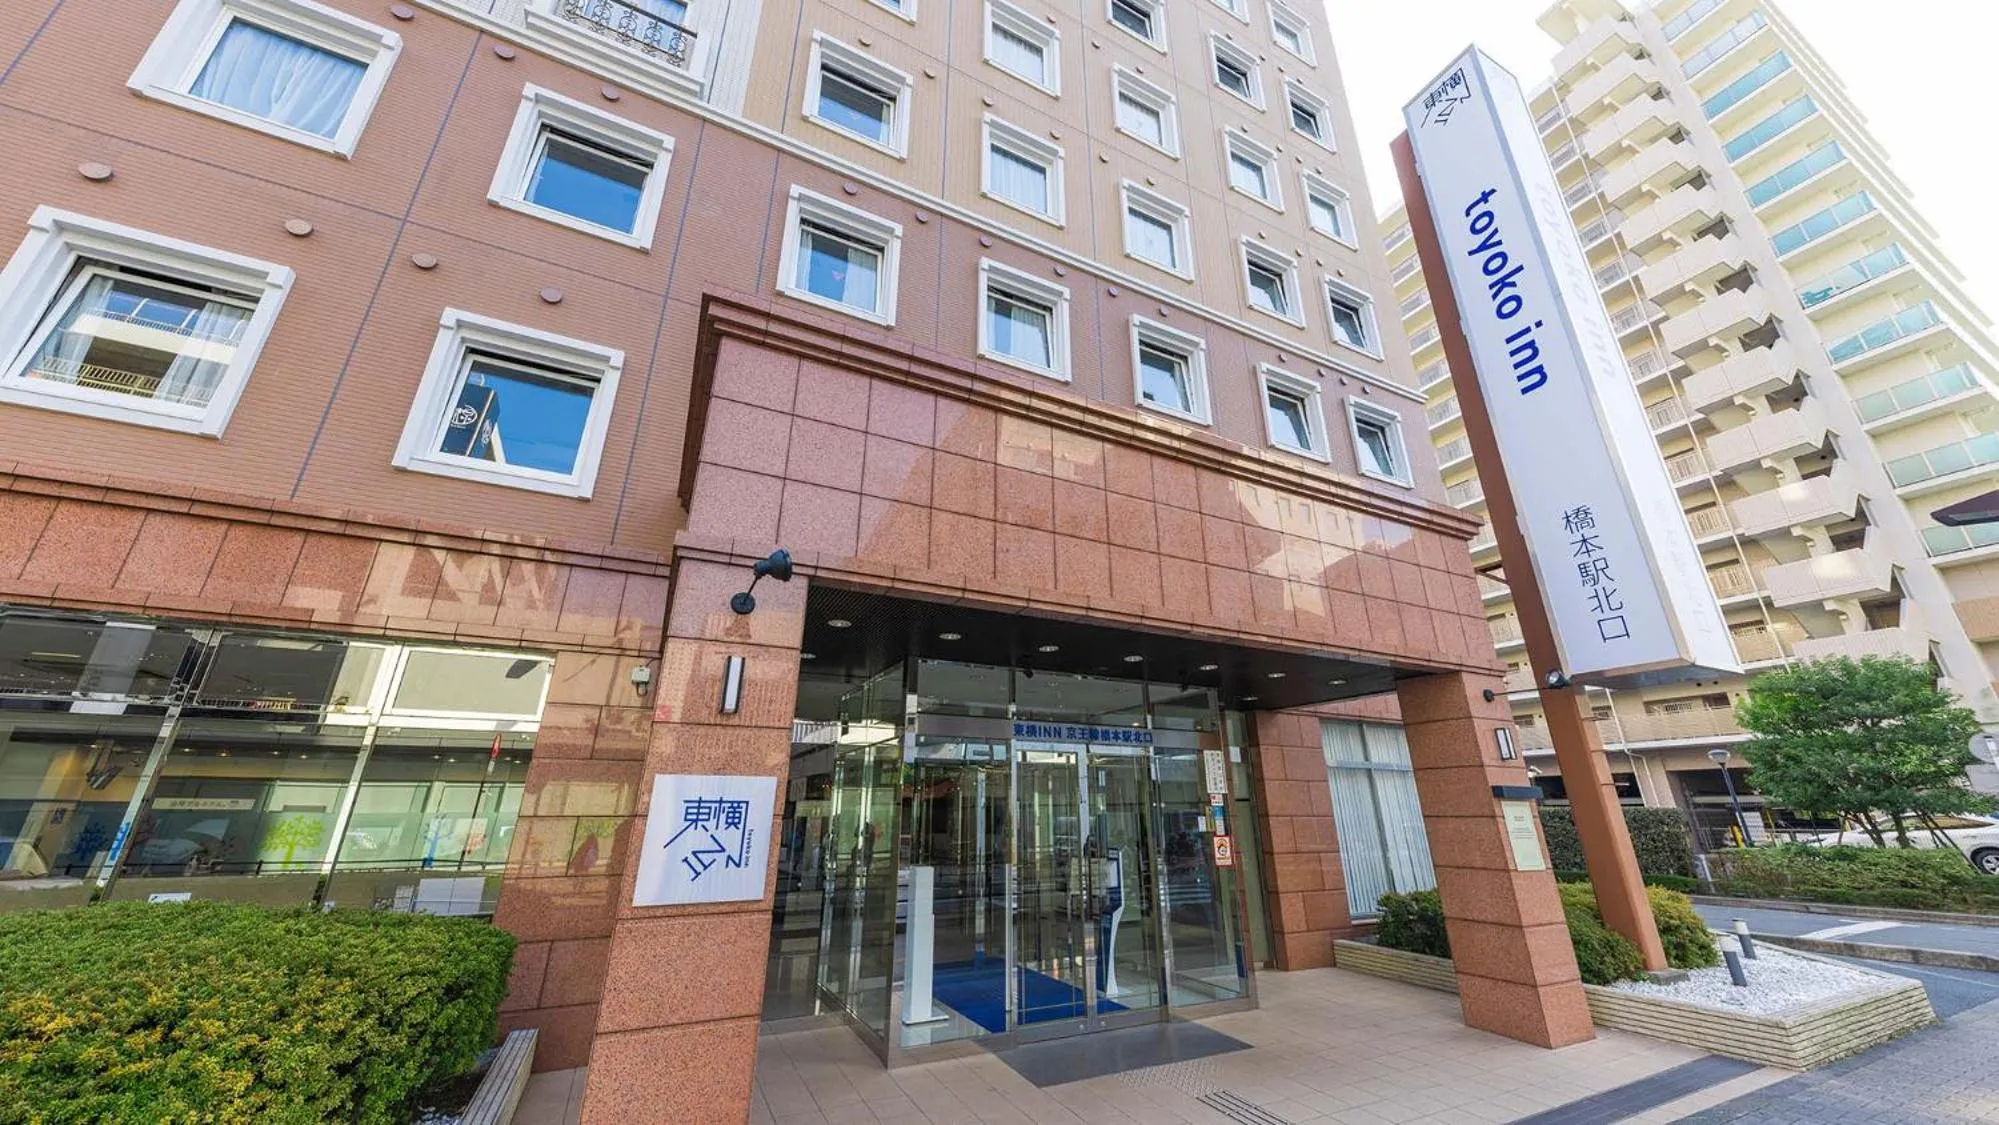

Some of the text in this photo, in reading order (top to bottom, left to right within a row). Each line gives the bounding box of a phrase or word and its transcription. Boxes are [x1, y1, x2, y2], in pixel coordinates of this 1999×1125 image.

[1465, 188, 1549, 396] toyoko inn
[1562, 504, 1631, 643] 橋本駅北口
[1013, 723, 1062, 739] 東横INN
